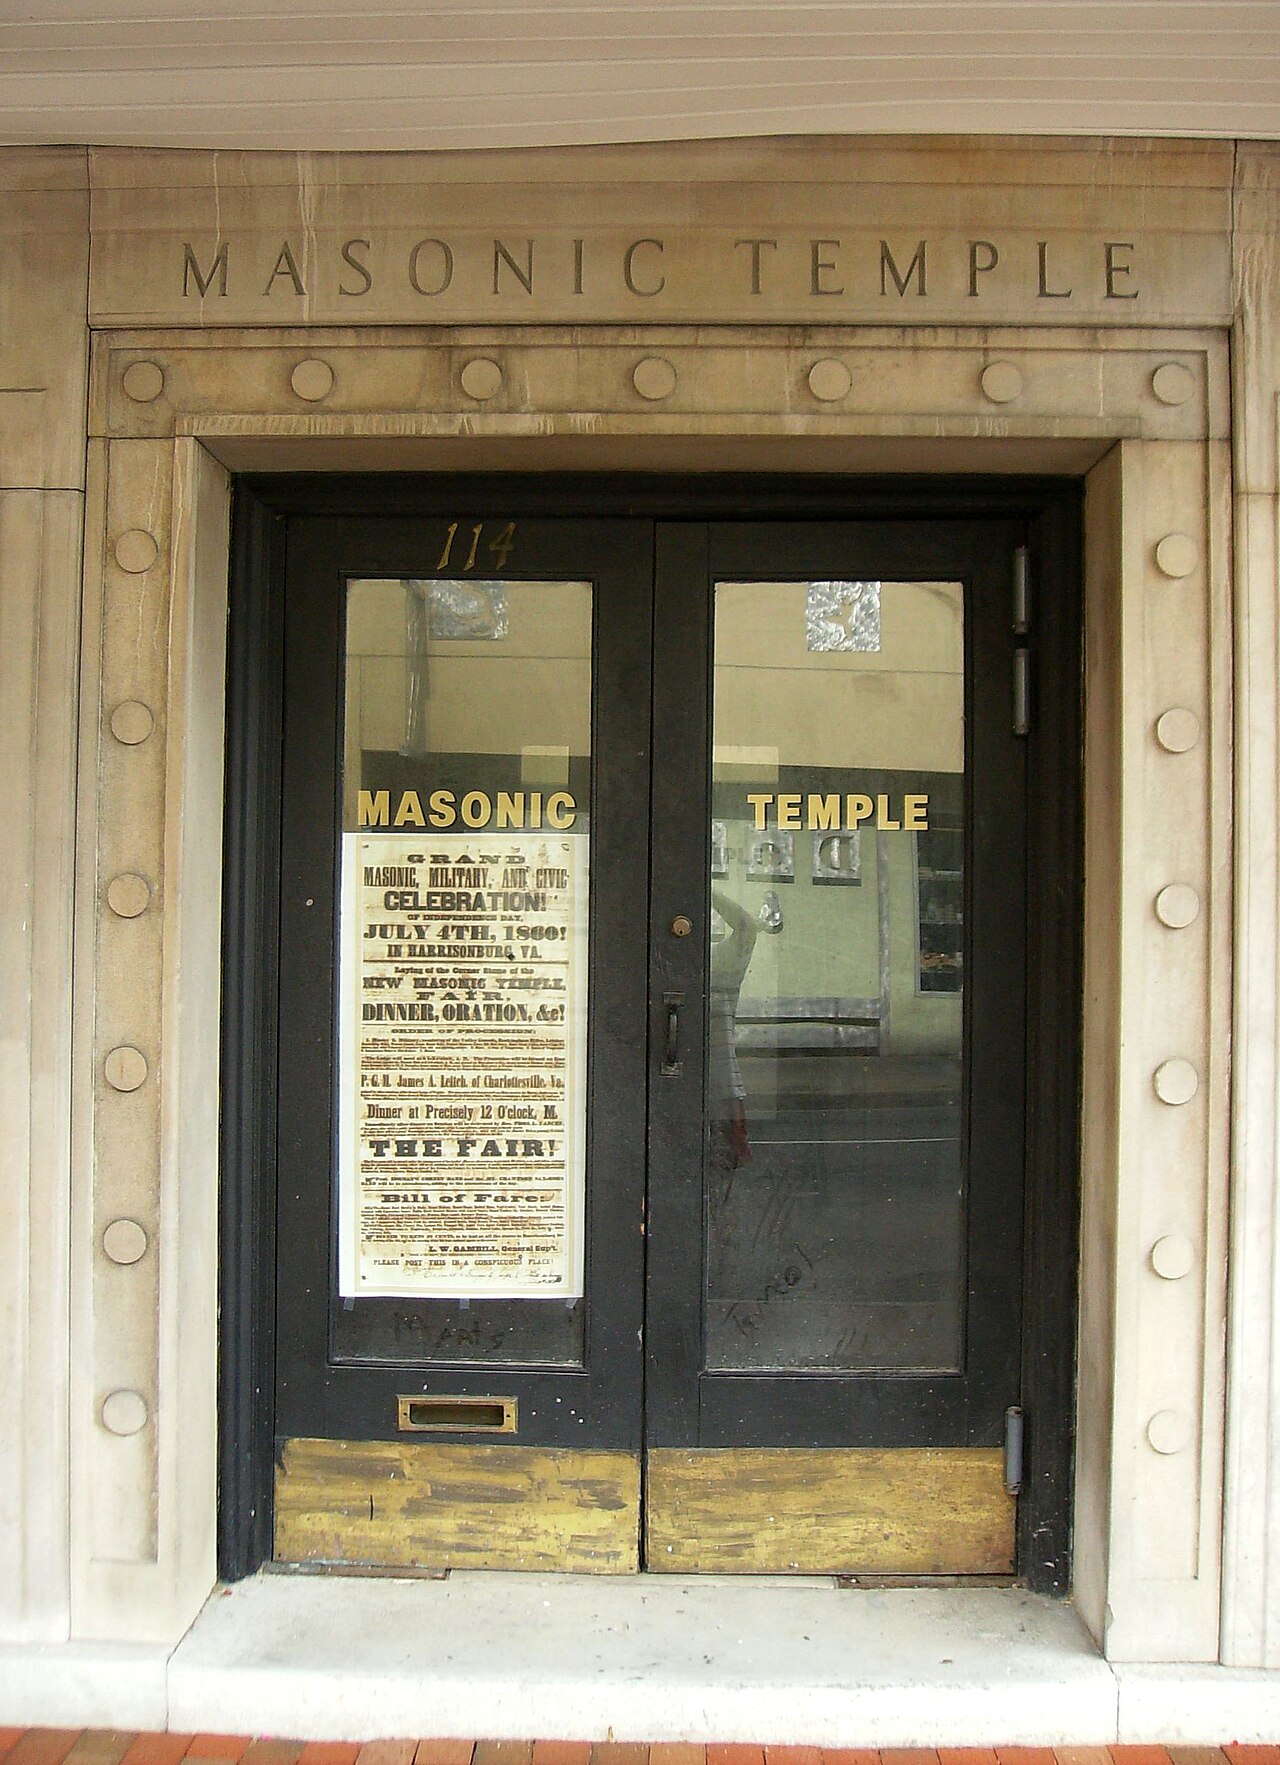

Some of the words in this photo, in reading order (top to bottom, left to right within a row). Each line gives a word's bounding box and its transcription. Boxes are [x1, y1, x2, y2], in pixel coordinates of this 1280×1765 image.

[181, 238, 667, 298] MASONIC
[733, 238, 1140, 299] TEMPLE
[436, 521, 517, 571] 114
[356, 789, 578, 830] MASONIC
[746, 793, 930, 832] TEMPLE
[407, 854, 525, 864] GRAND
[364, 867, 419, 889] MASONIC,
[429, 868, 493, 889] MILITARY,
[502, 868, 526, 889] AND
[536, 869, 567, 889] CIVIC
[384, 891, 547, 911] CELEBRATION!
[363, 925, 429, 940] JULY
[436, 925, 496, 943] 4TH,
[503, 926, 566, 941] 1860!
[387, 945, 402, 957] IN
[363, 978, 403, 989] NEW
[413, 978, 486, 989] MASONIC
[362, 1004, 439, 1022] DINNER,
[443, 1005, 532, 1022] ORATION,
[397, 1075, 424, 1088] James
[472, 1075, 481, 1088] of
[367, 1104, 402, 1119] Dinner
[409, 1106, 419, 1119] at
[425, 1105, 474, 1122] Precisely
[480, 1106, 492, 1119] 12
[369, 1140, 442, 1157] THE
[457, 1140, 555, 1157] FAIR!
[381, 1194, 429, 1203] Bill
[439, 1194, 464, 1203] of
